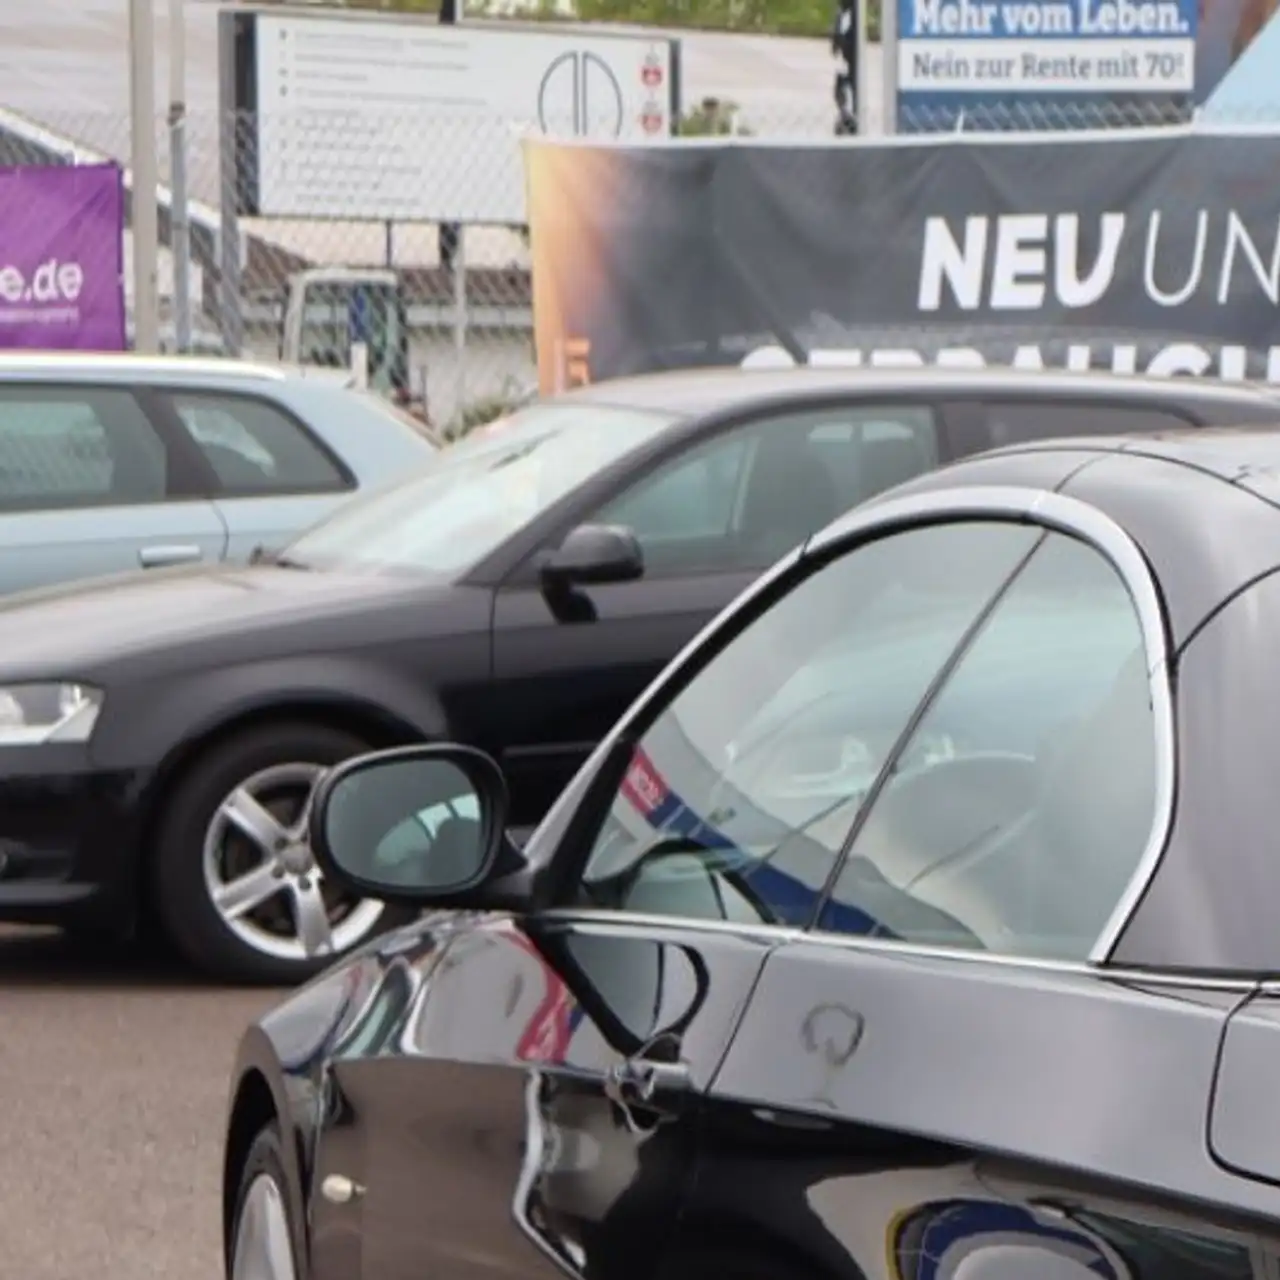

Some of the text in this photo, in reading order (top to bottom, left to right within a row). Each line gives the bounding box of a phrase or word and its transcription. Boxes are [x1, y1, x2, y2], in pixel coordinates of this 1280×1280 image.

[912, 0, 1190, 34] Mehr vom Leben.
[912, 52, 969, 79] Nein
[975, 60, 1015, 79] zur
[1020, 52, 1091, 80] Rente
[1096, 50, 1139, 79] mit
[917, 212, 1126, 311] NEU
